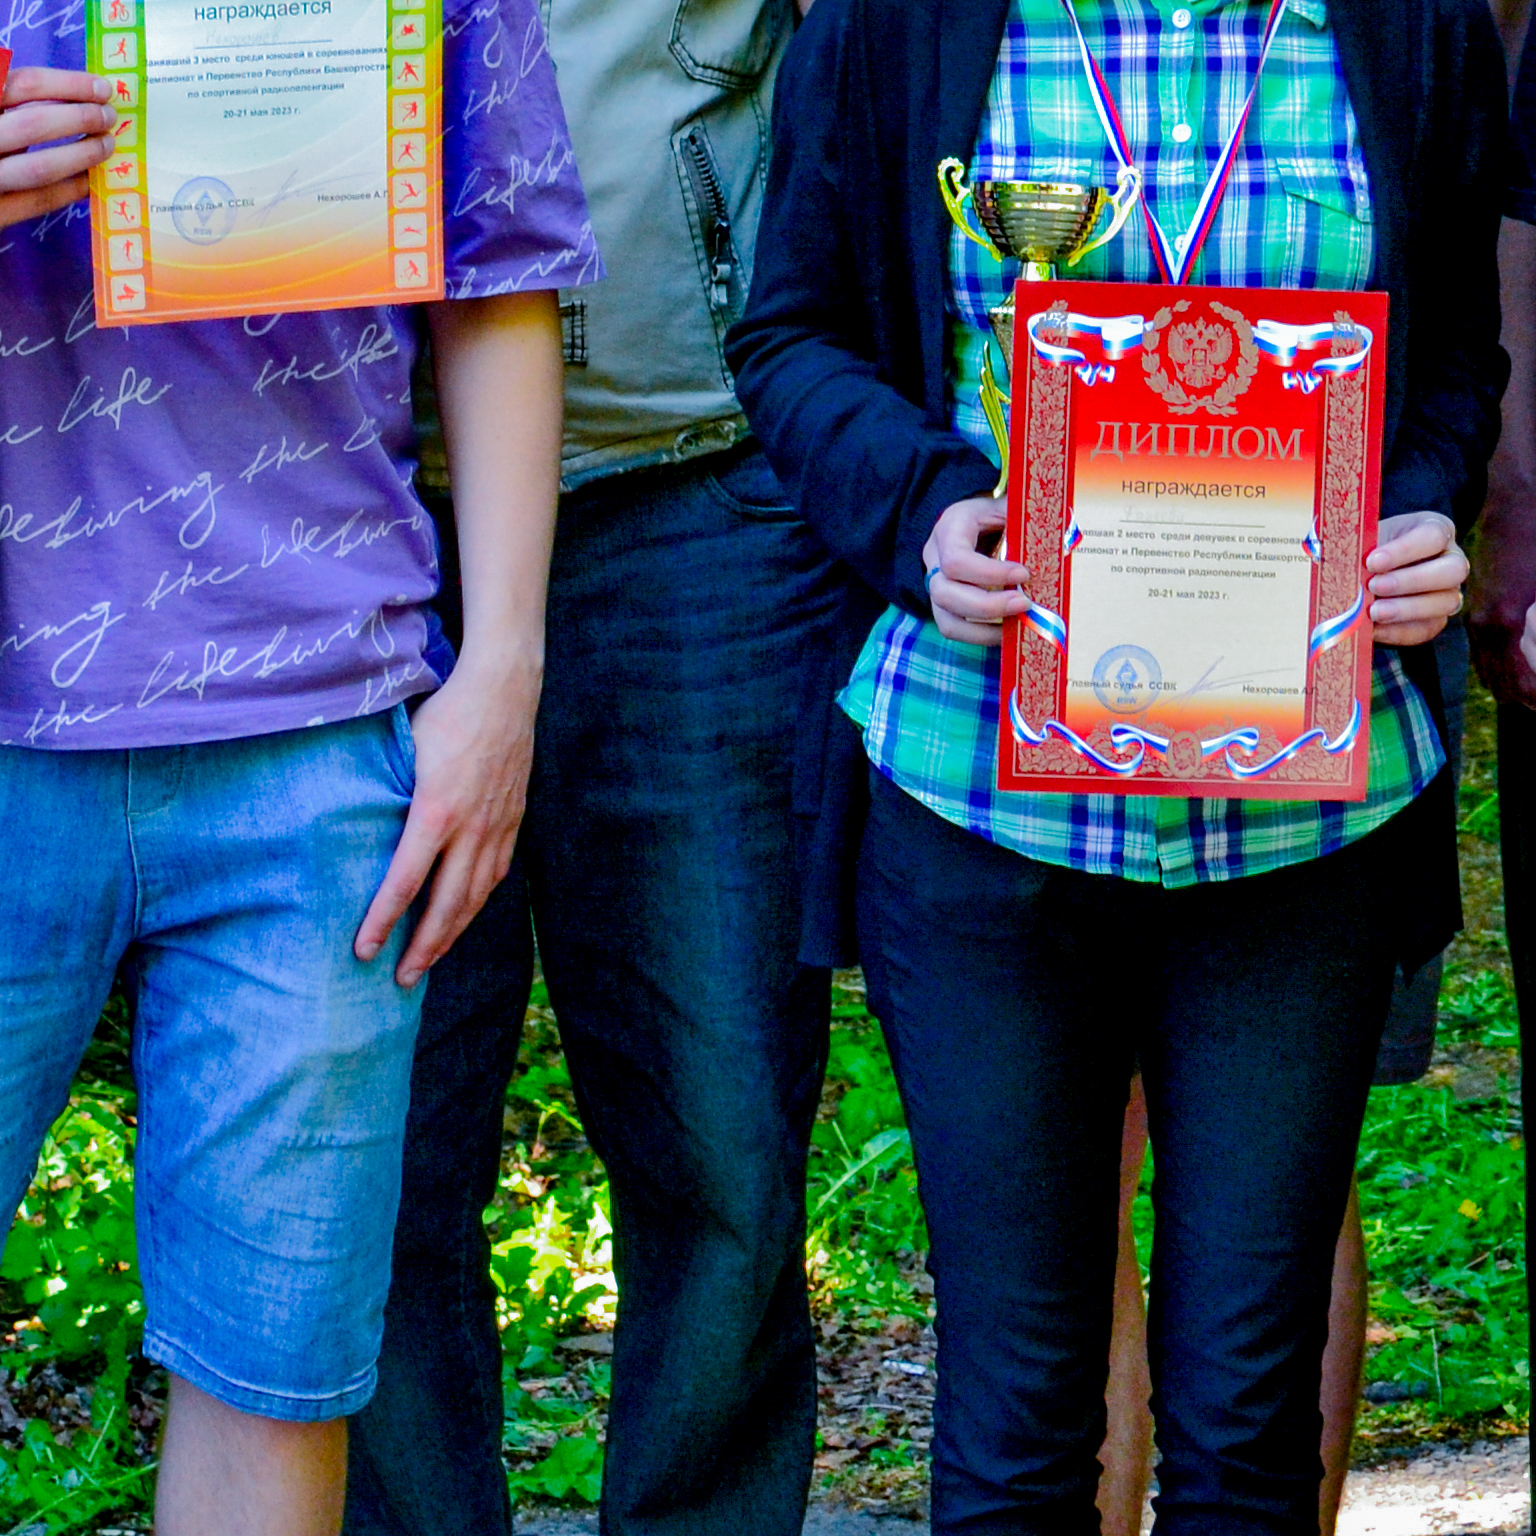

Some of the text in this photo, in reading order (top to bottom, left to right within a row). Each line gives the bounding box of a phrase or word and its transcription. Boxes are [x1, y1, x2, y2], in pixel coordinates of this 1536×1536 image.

[194, 0, 332, 24] награждается
[202, 55, 231, 64] место
[235, 53, 264, 64] среди
[266, 51, 305, 61] юношей
[206, 70, 263, 82] Первенство
[265, 66, 321, 79] Республики
[187, 91, 200, 99] по
[202, 86, 259, 99] спортивной
[223, 109, 248, 119] 20-21
[250, 107, 269, 116] мая
[271, 106, 293, 116] 2023
[317, 192, 371, 204] Нехорошев
[1090, 421, 1304, 462] ДИПЛОМ
[1121, 478, 1267, 499] награждается
[1125, 530, 1156, 540] место
[1160, 531, 1192, 542] среди
[1193, 533, 1236, 544] девушек
[1131, 547, 1191, 559] Первенство
[1193, 549, 1253, 561] Республики
[1110, 565, 1124, 574] по
[1125, 565, 1186, 576] спортивной
[1147, 588, 1173, 598] 20-21
[1176, 590, 1196, 599] мая
[1197, 590, 1220, 601] 2023
[1148, 681, 1177, 692] ССВК
[1242, 684, 1299, 696] Нехорошев
